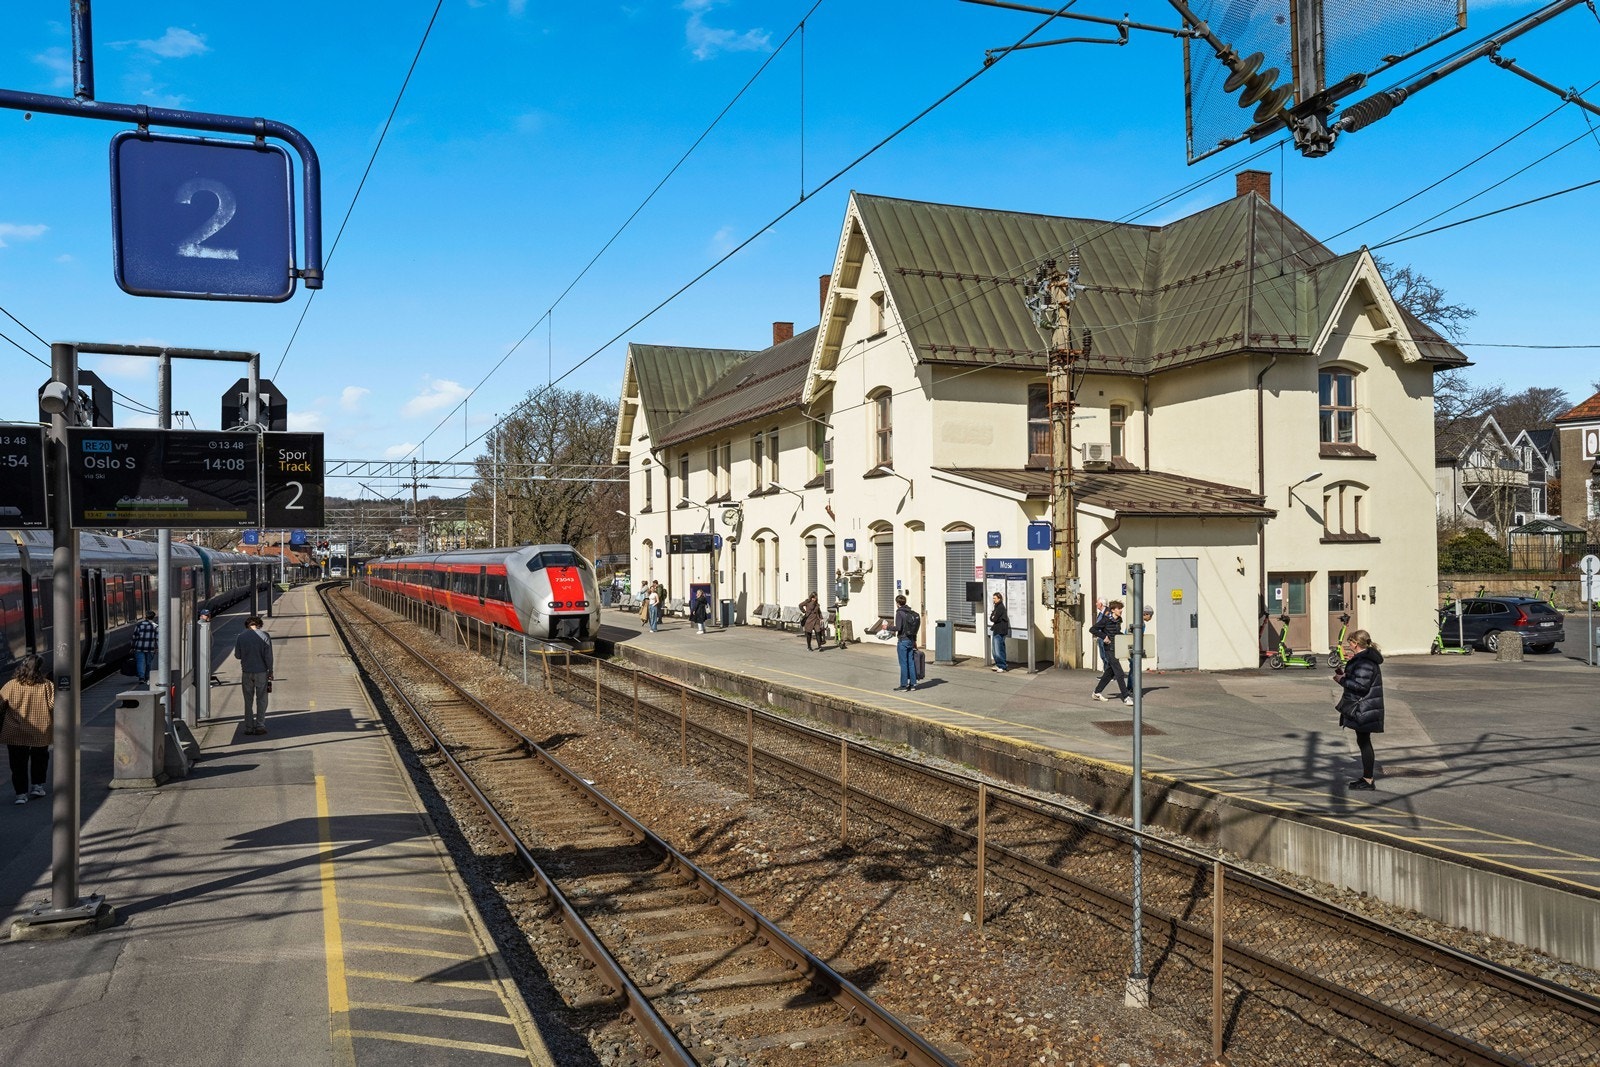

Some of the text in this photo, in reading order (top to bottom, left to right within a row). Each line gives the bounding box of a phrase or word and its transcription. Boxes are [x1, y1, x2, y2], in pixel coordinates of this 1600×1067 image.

[176, 177, 239, 260] 2
[13, 436, 27, 445] 48
[85, 442, 98, 451] RE
[99, 442, 111, 451] 20
[218, 441, 244, 450] 13 48
[278, 448, 307, 462] Spor
[84, 456, 136, 470] Oslo S
[203, 458, 245, 471] 14:08
[278, 460, 312, 472] Track
[284, 480, 305, 510] 2
[249, 534, 255, 542] 3
[295, 534, 301, 542] 2
[1036, 531, 1041, 545] 1
[1000, 560, 1013, 569] Moss
